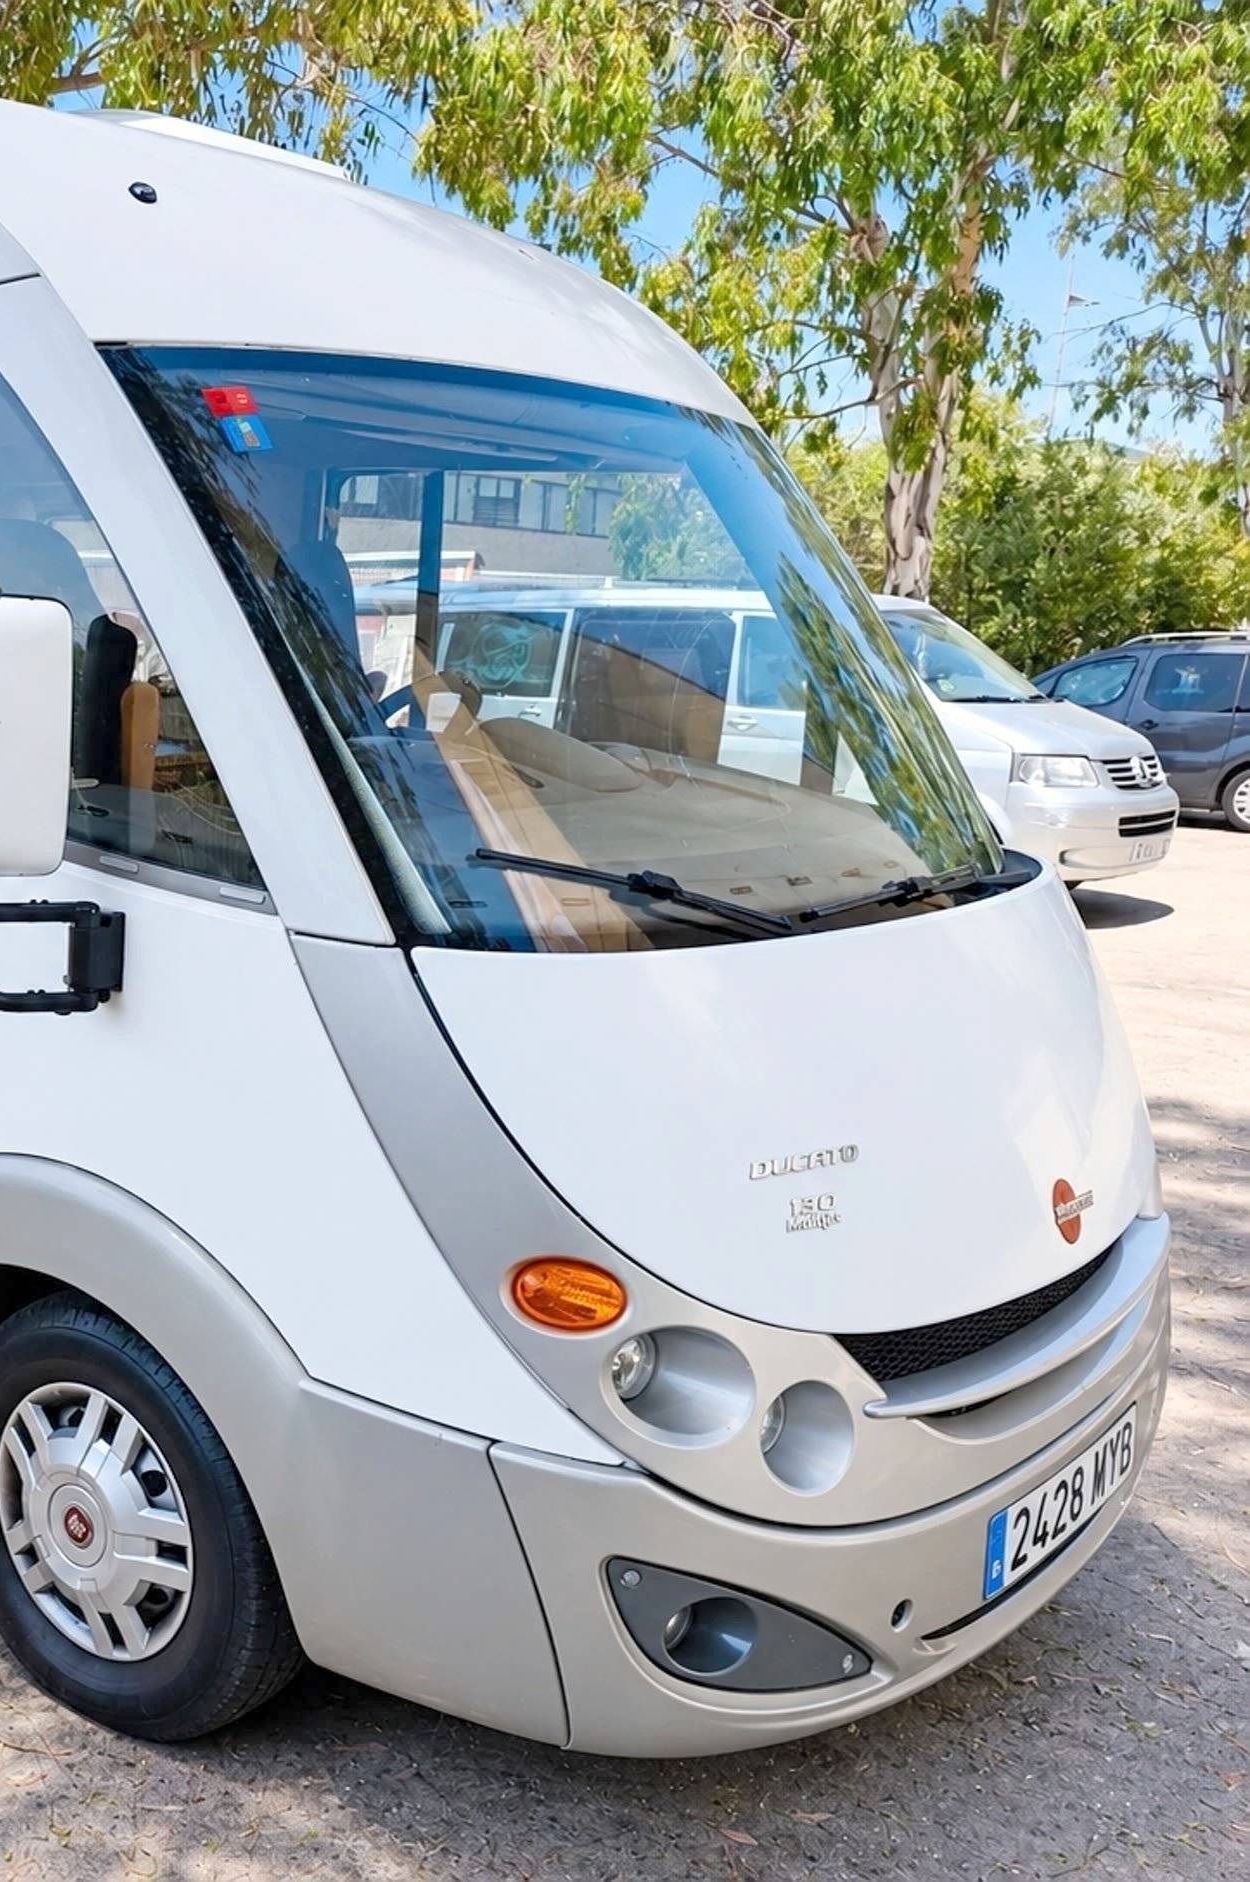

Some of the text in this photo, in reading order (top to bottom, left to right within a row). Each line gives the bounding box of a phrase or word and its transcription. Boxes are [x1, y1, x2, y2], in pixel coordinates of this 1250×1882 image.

[749, 1144, 859, 1180] DUCATO
[1010, 1421, 1133, 1572] 2428 MYB
